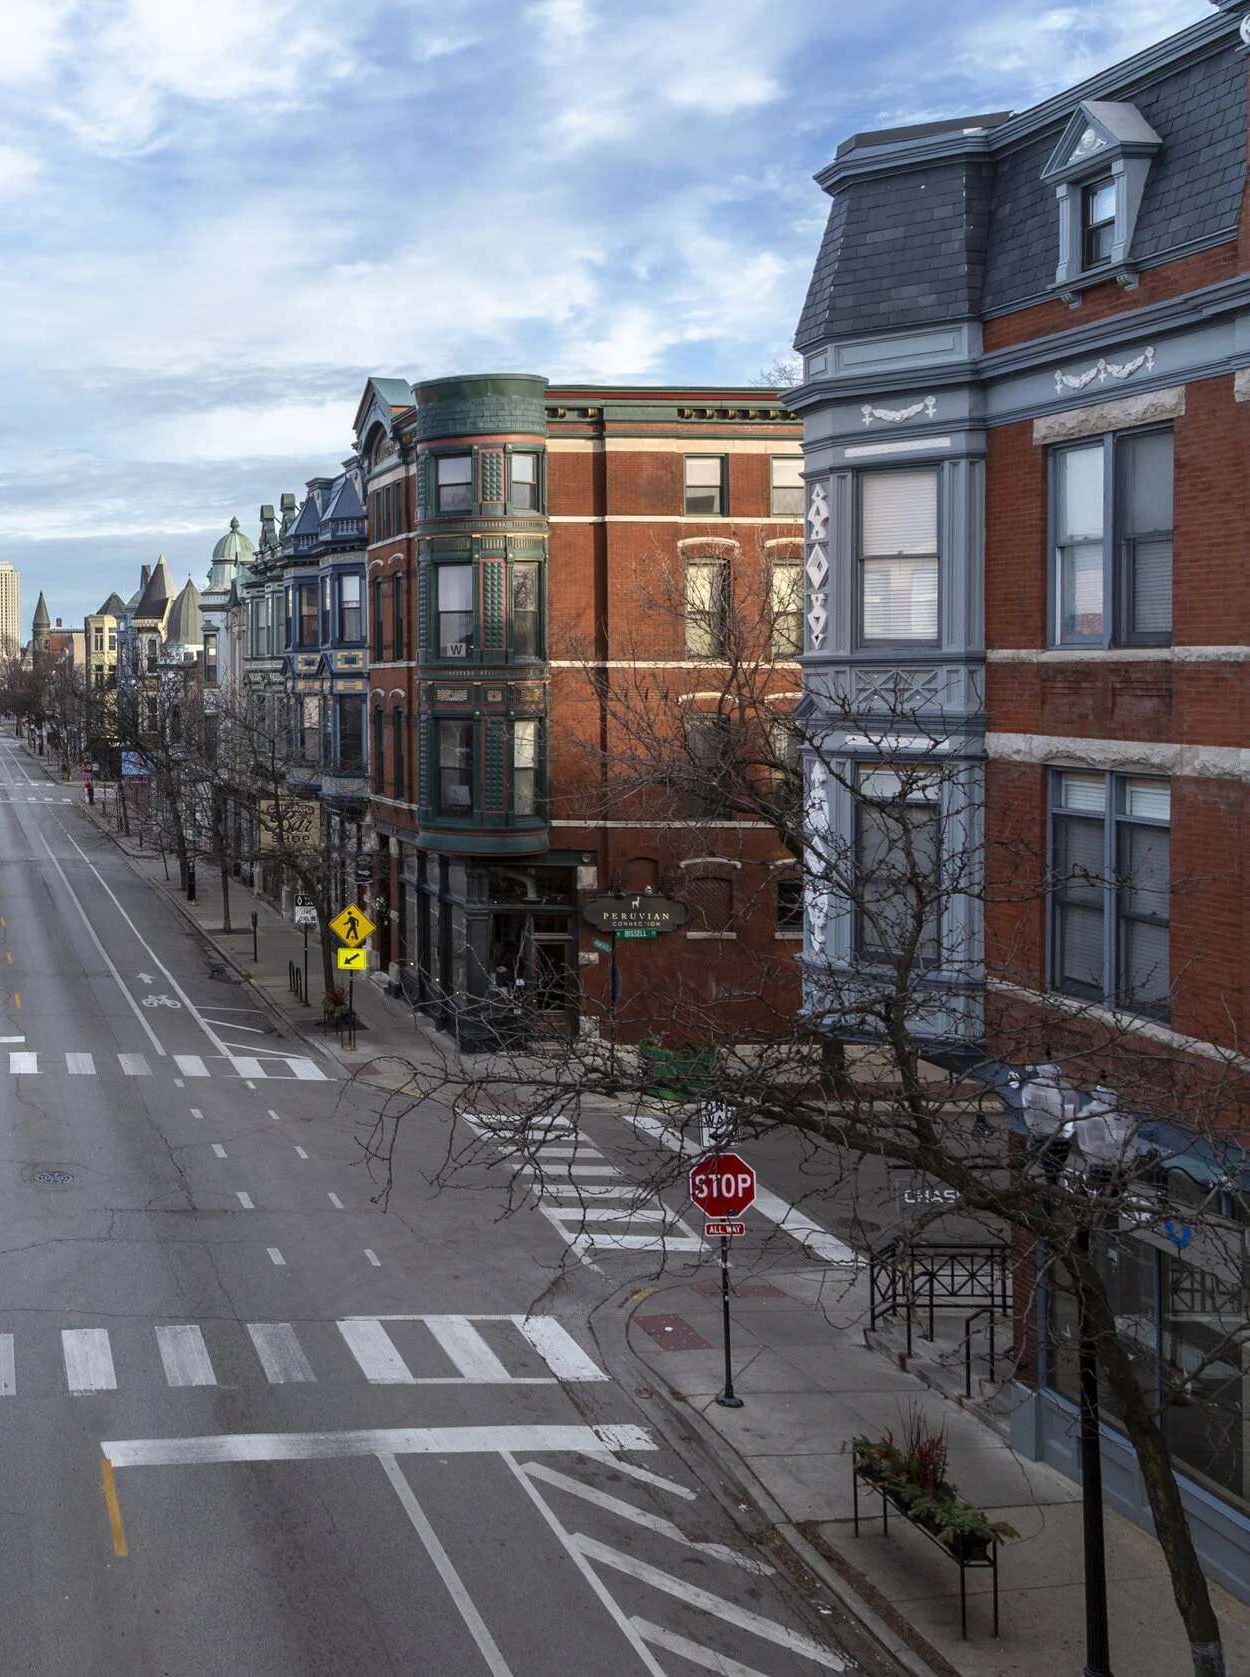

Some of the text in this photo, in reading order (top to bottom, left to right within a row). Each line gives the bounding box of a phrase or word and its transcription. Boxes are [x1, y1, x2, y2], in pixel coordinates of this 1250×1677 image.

[450, 644, 463, 656] W
[603, 912, 670, 920] PERUVIAN
[695, 1173, 751, 1199] STOP
[709, 1225, 741, 1234] ALL WAY
